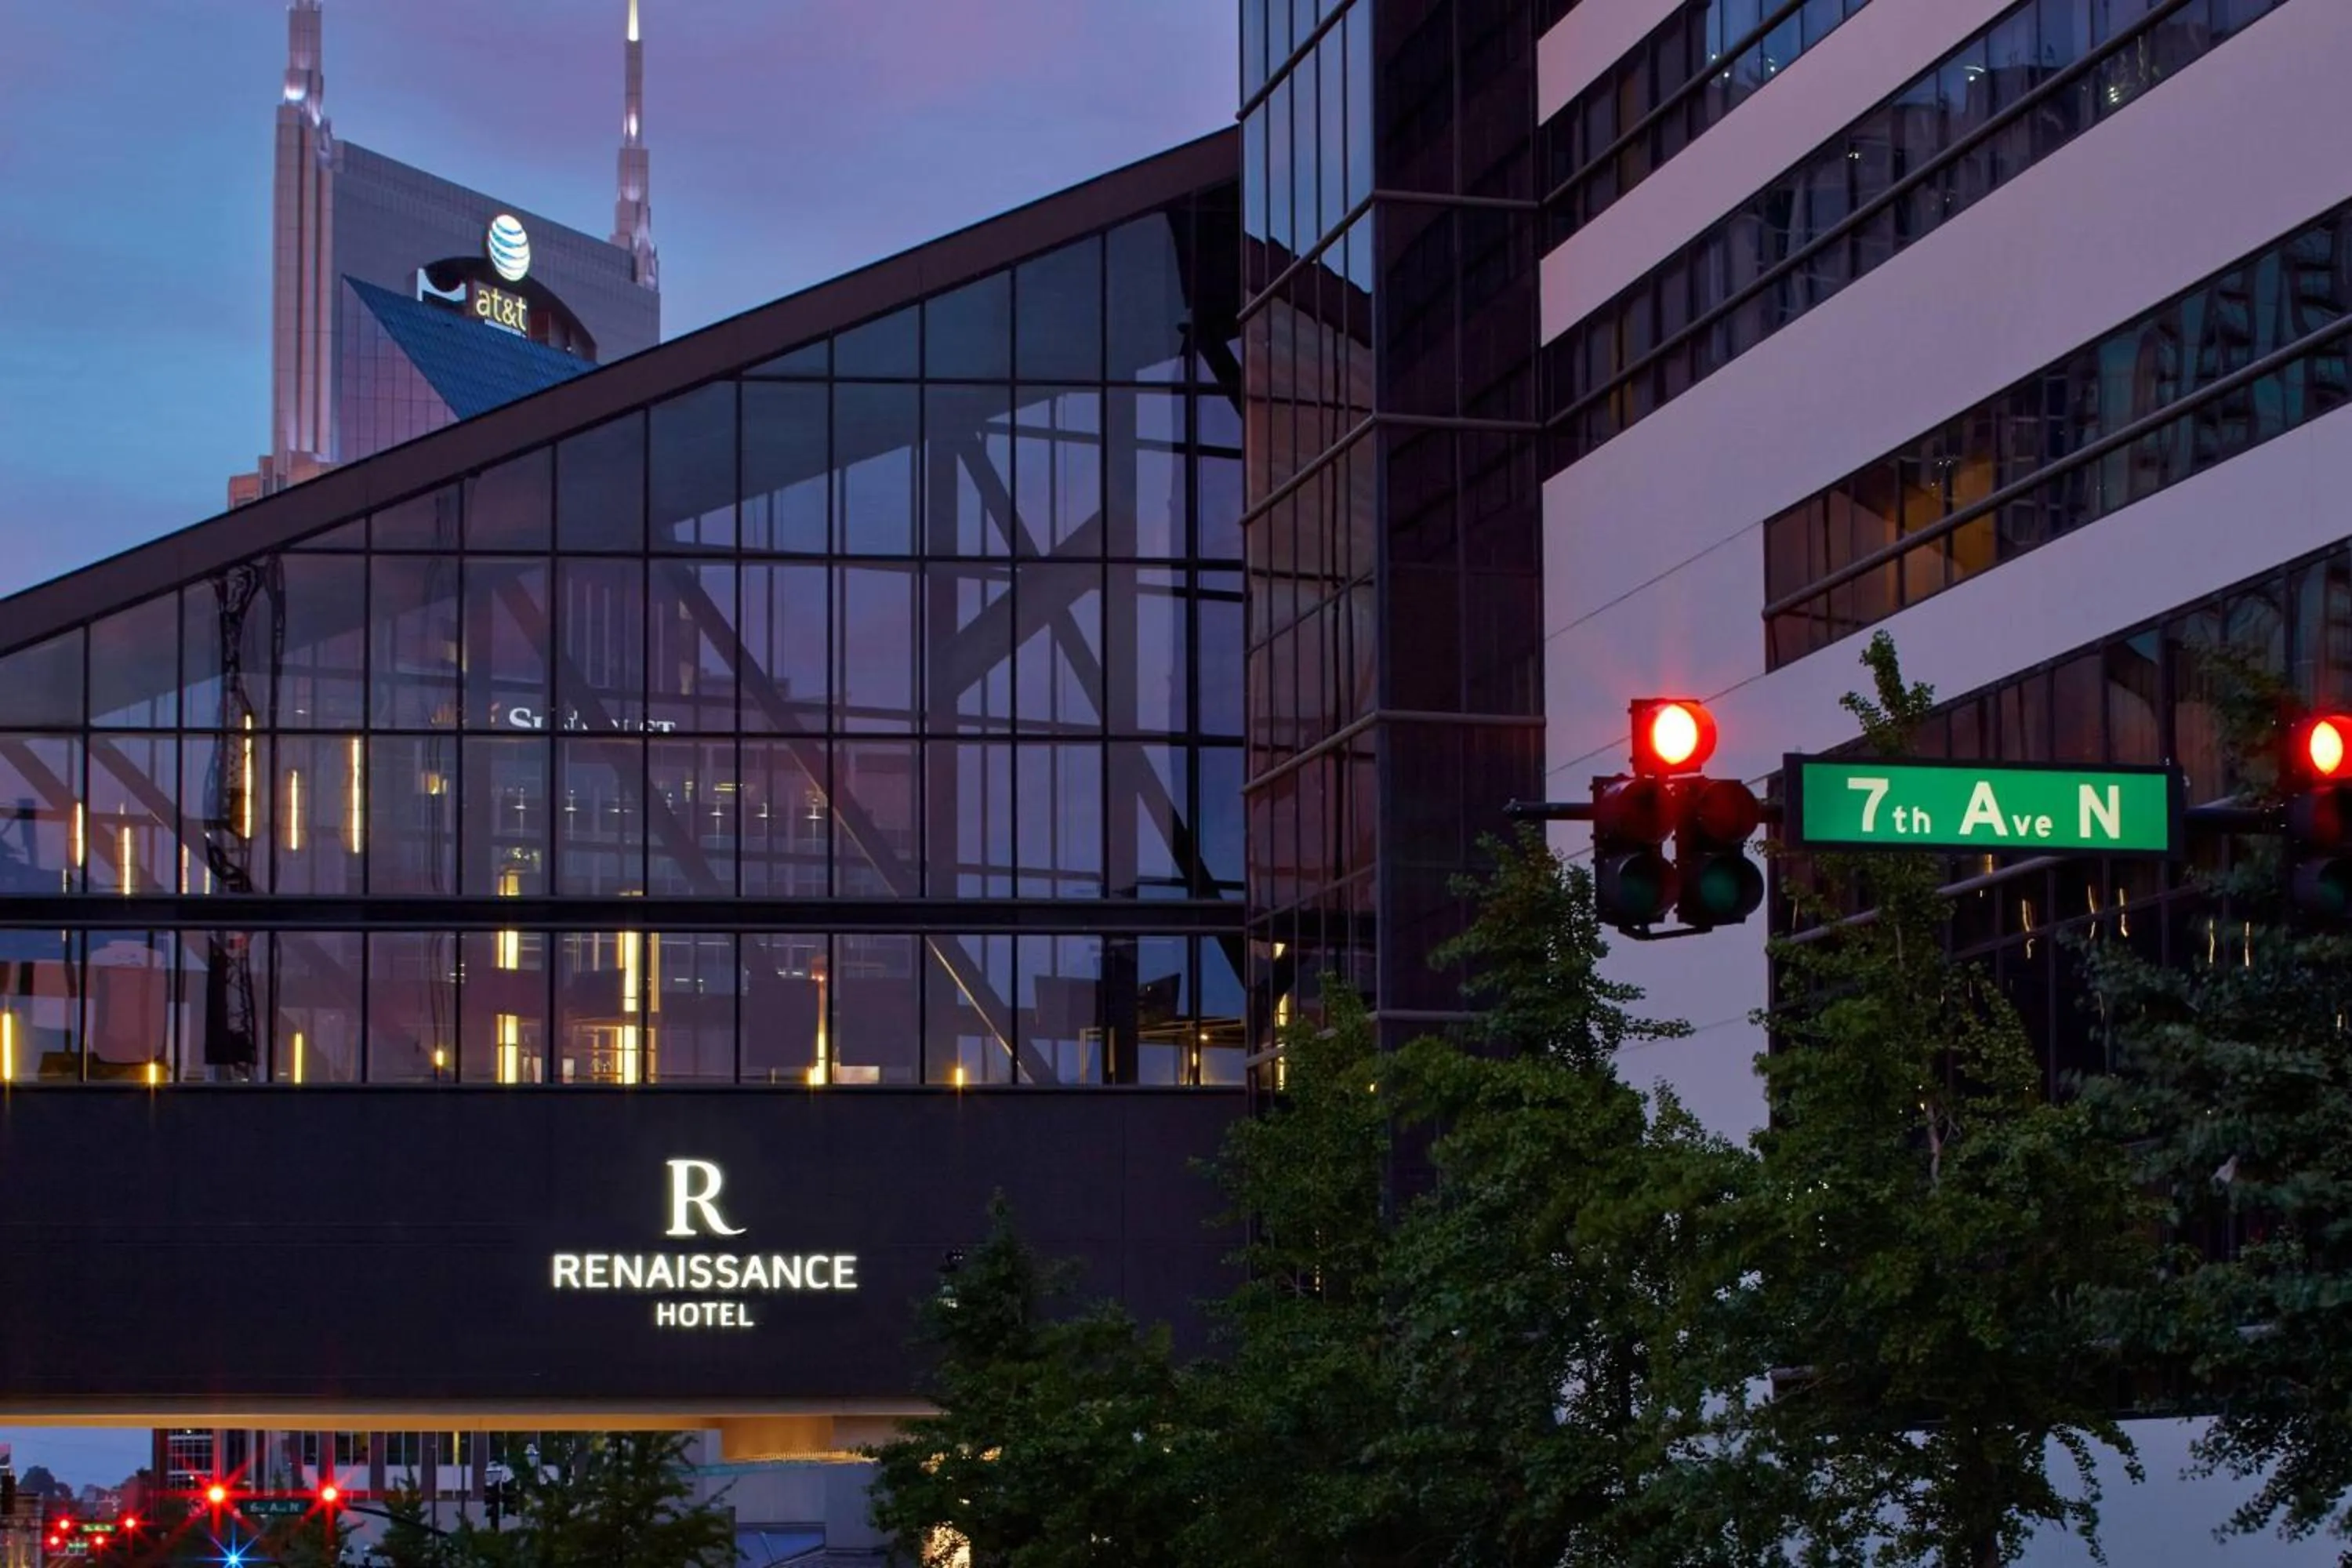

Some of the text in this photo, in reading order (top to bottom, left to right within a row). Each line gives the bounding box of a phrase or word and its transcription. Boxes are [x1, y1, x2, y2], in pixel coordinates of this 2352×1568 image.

[476, 288, 527, 332] at&t
[1847, 777, 2120, 839] 7th Ave N
[665, 1159, 747, 1237] R
[552, 1254, 858, 1290] RENAISSANCE
[656, 1301, 755, 1327] HOTEL
